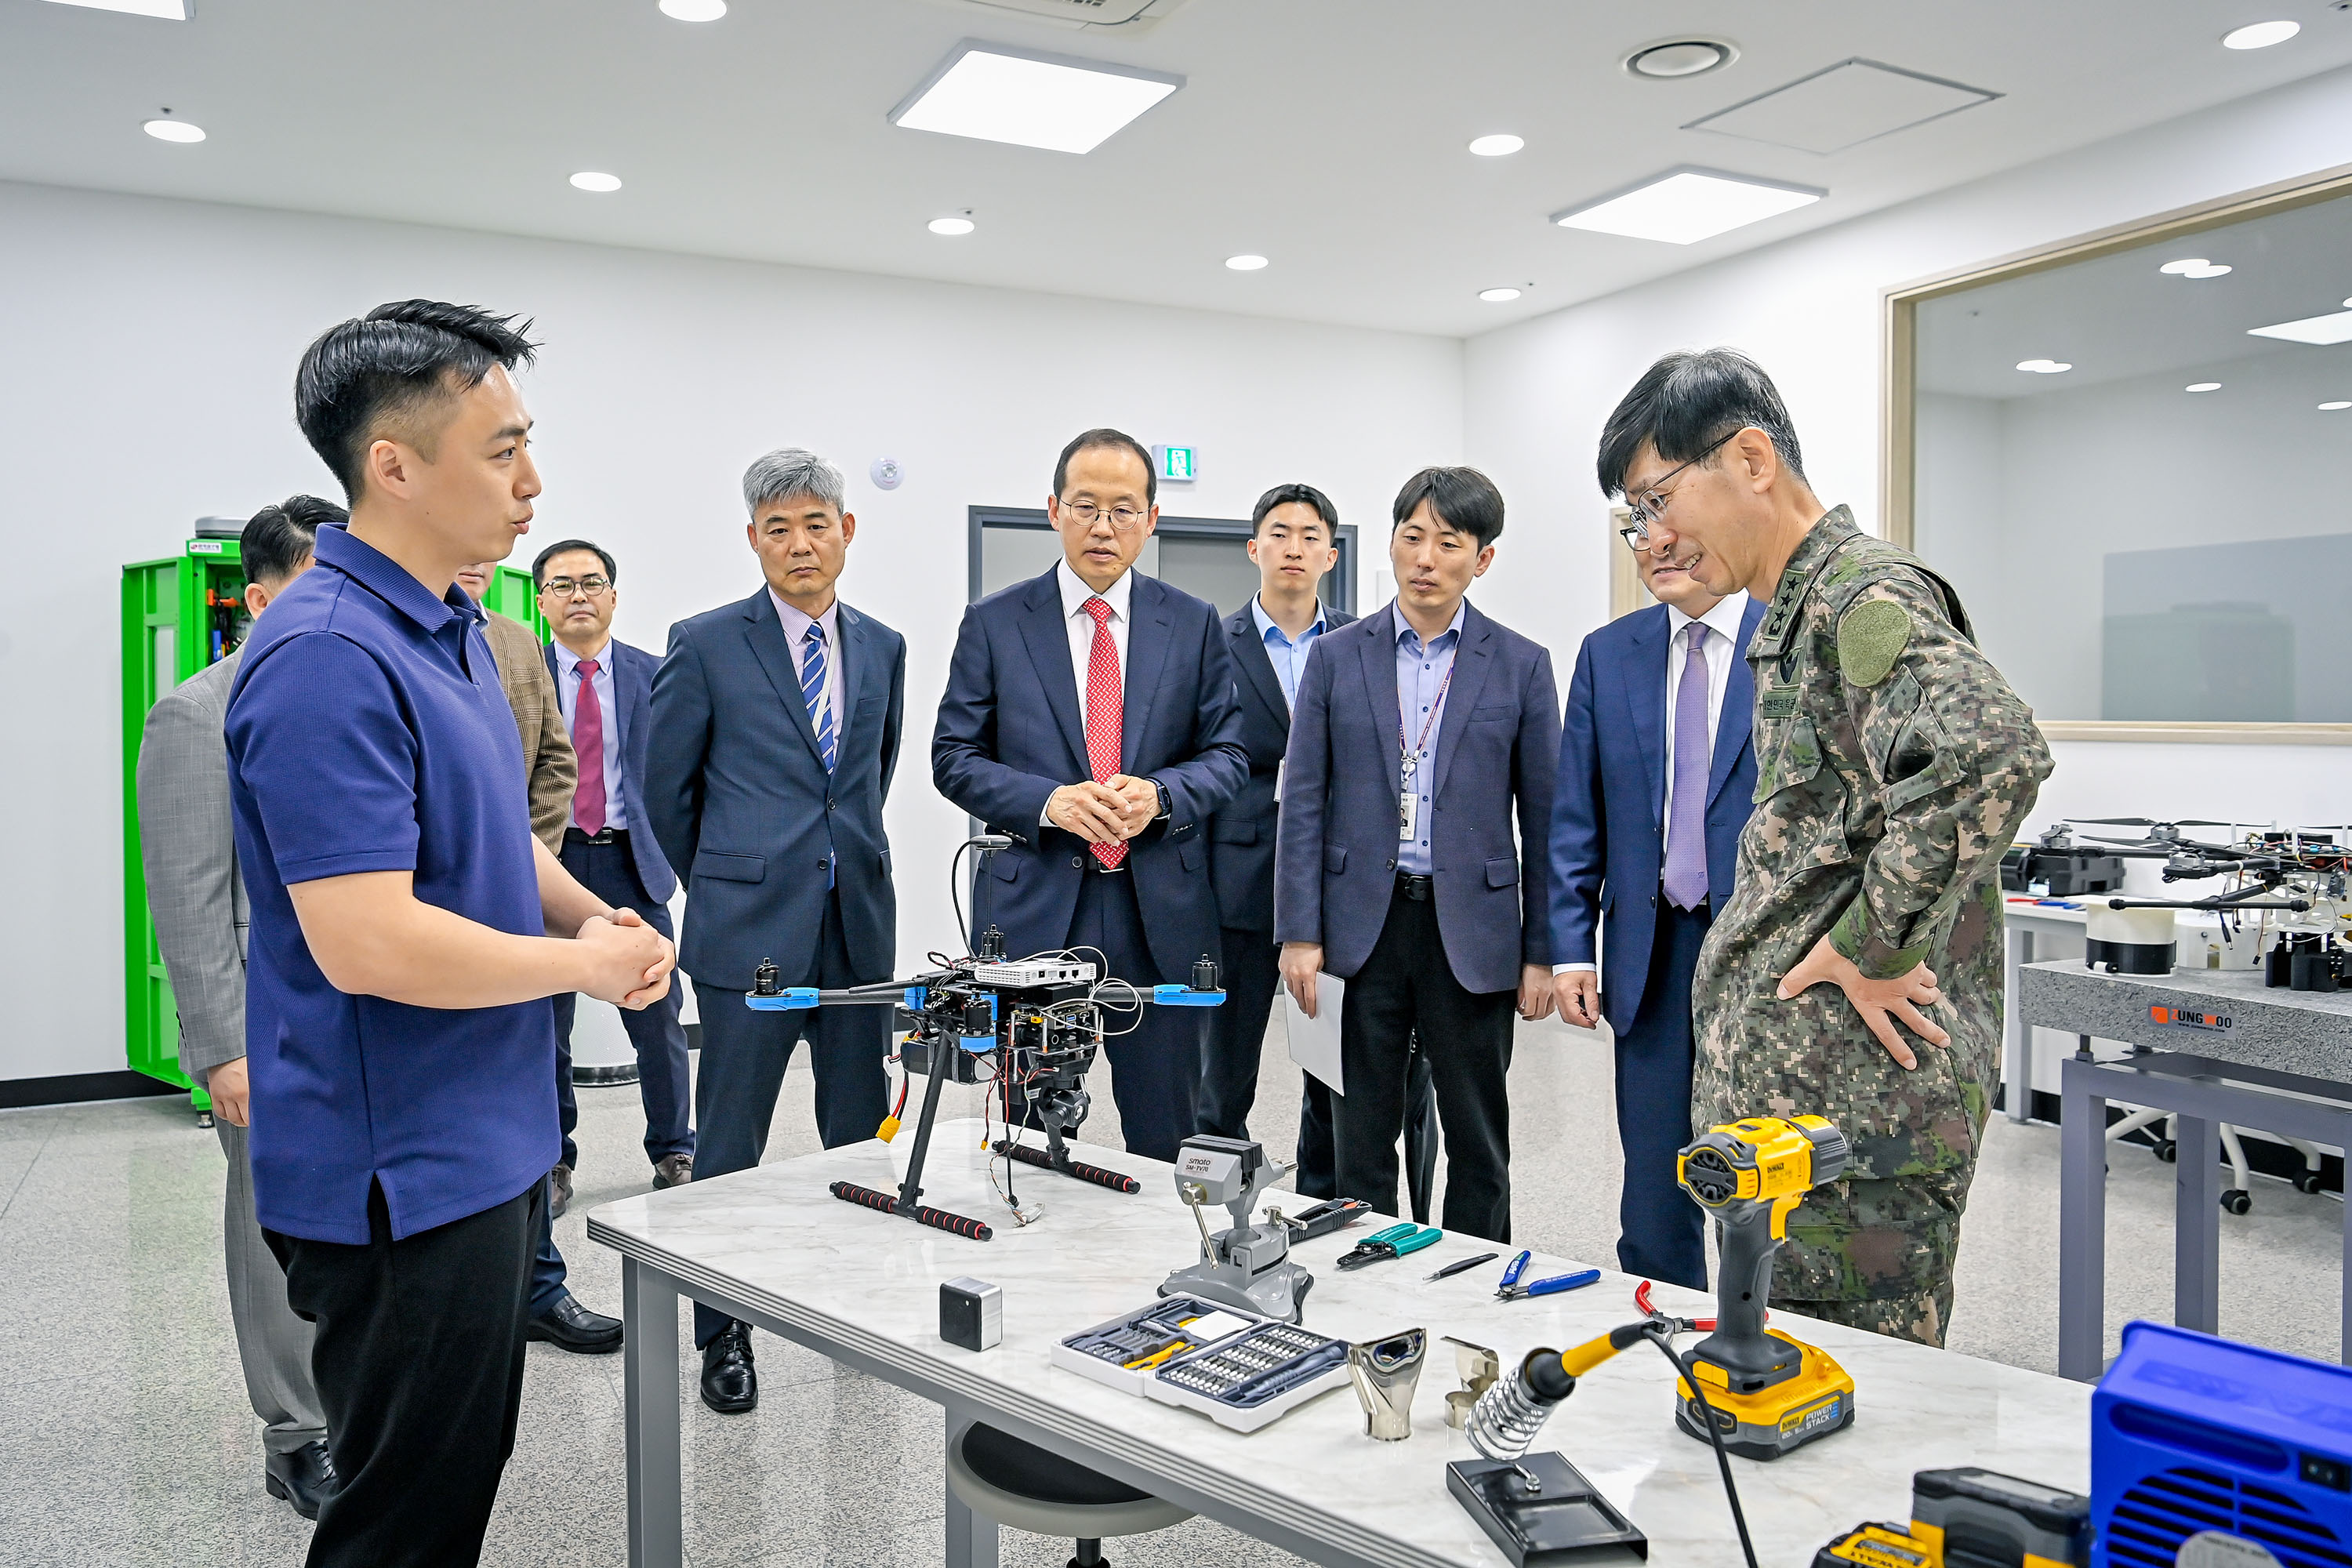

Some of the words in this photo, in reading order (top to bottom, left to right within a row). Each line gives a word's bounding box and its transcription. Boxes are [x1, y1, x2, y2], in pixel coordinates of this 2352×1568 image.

[2171, 1008, 2232, 1029] ZUNGWOO
[1806, 1404, 1832, 1422] POWER
[1806, 1414, 1830, 1430] STACK
